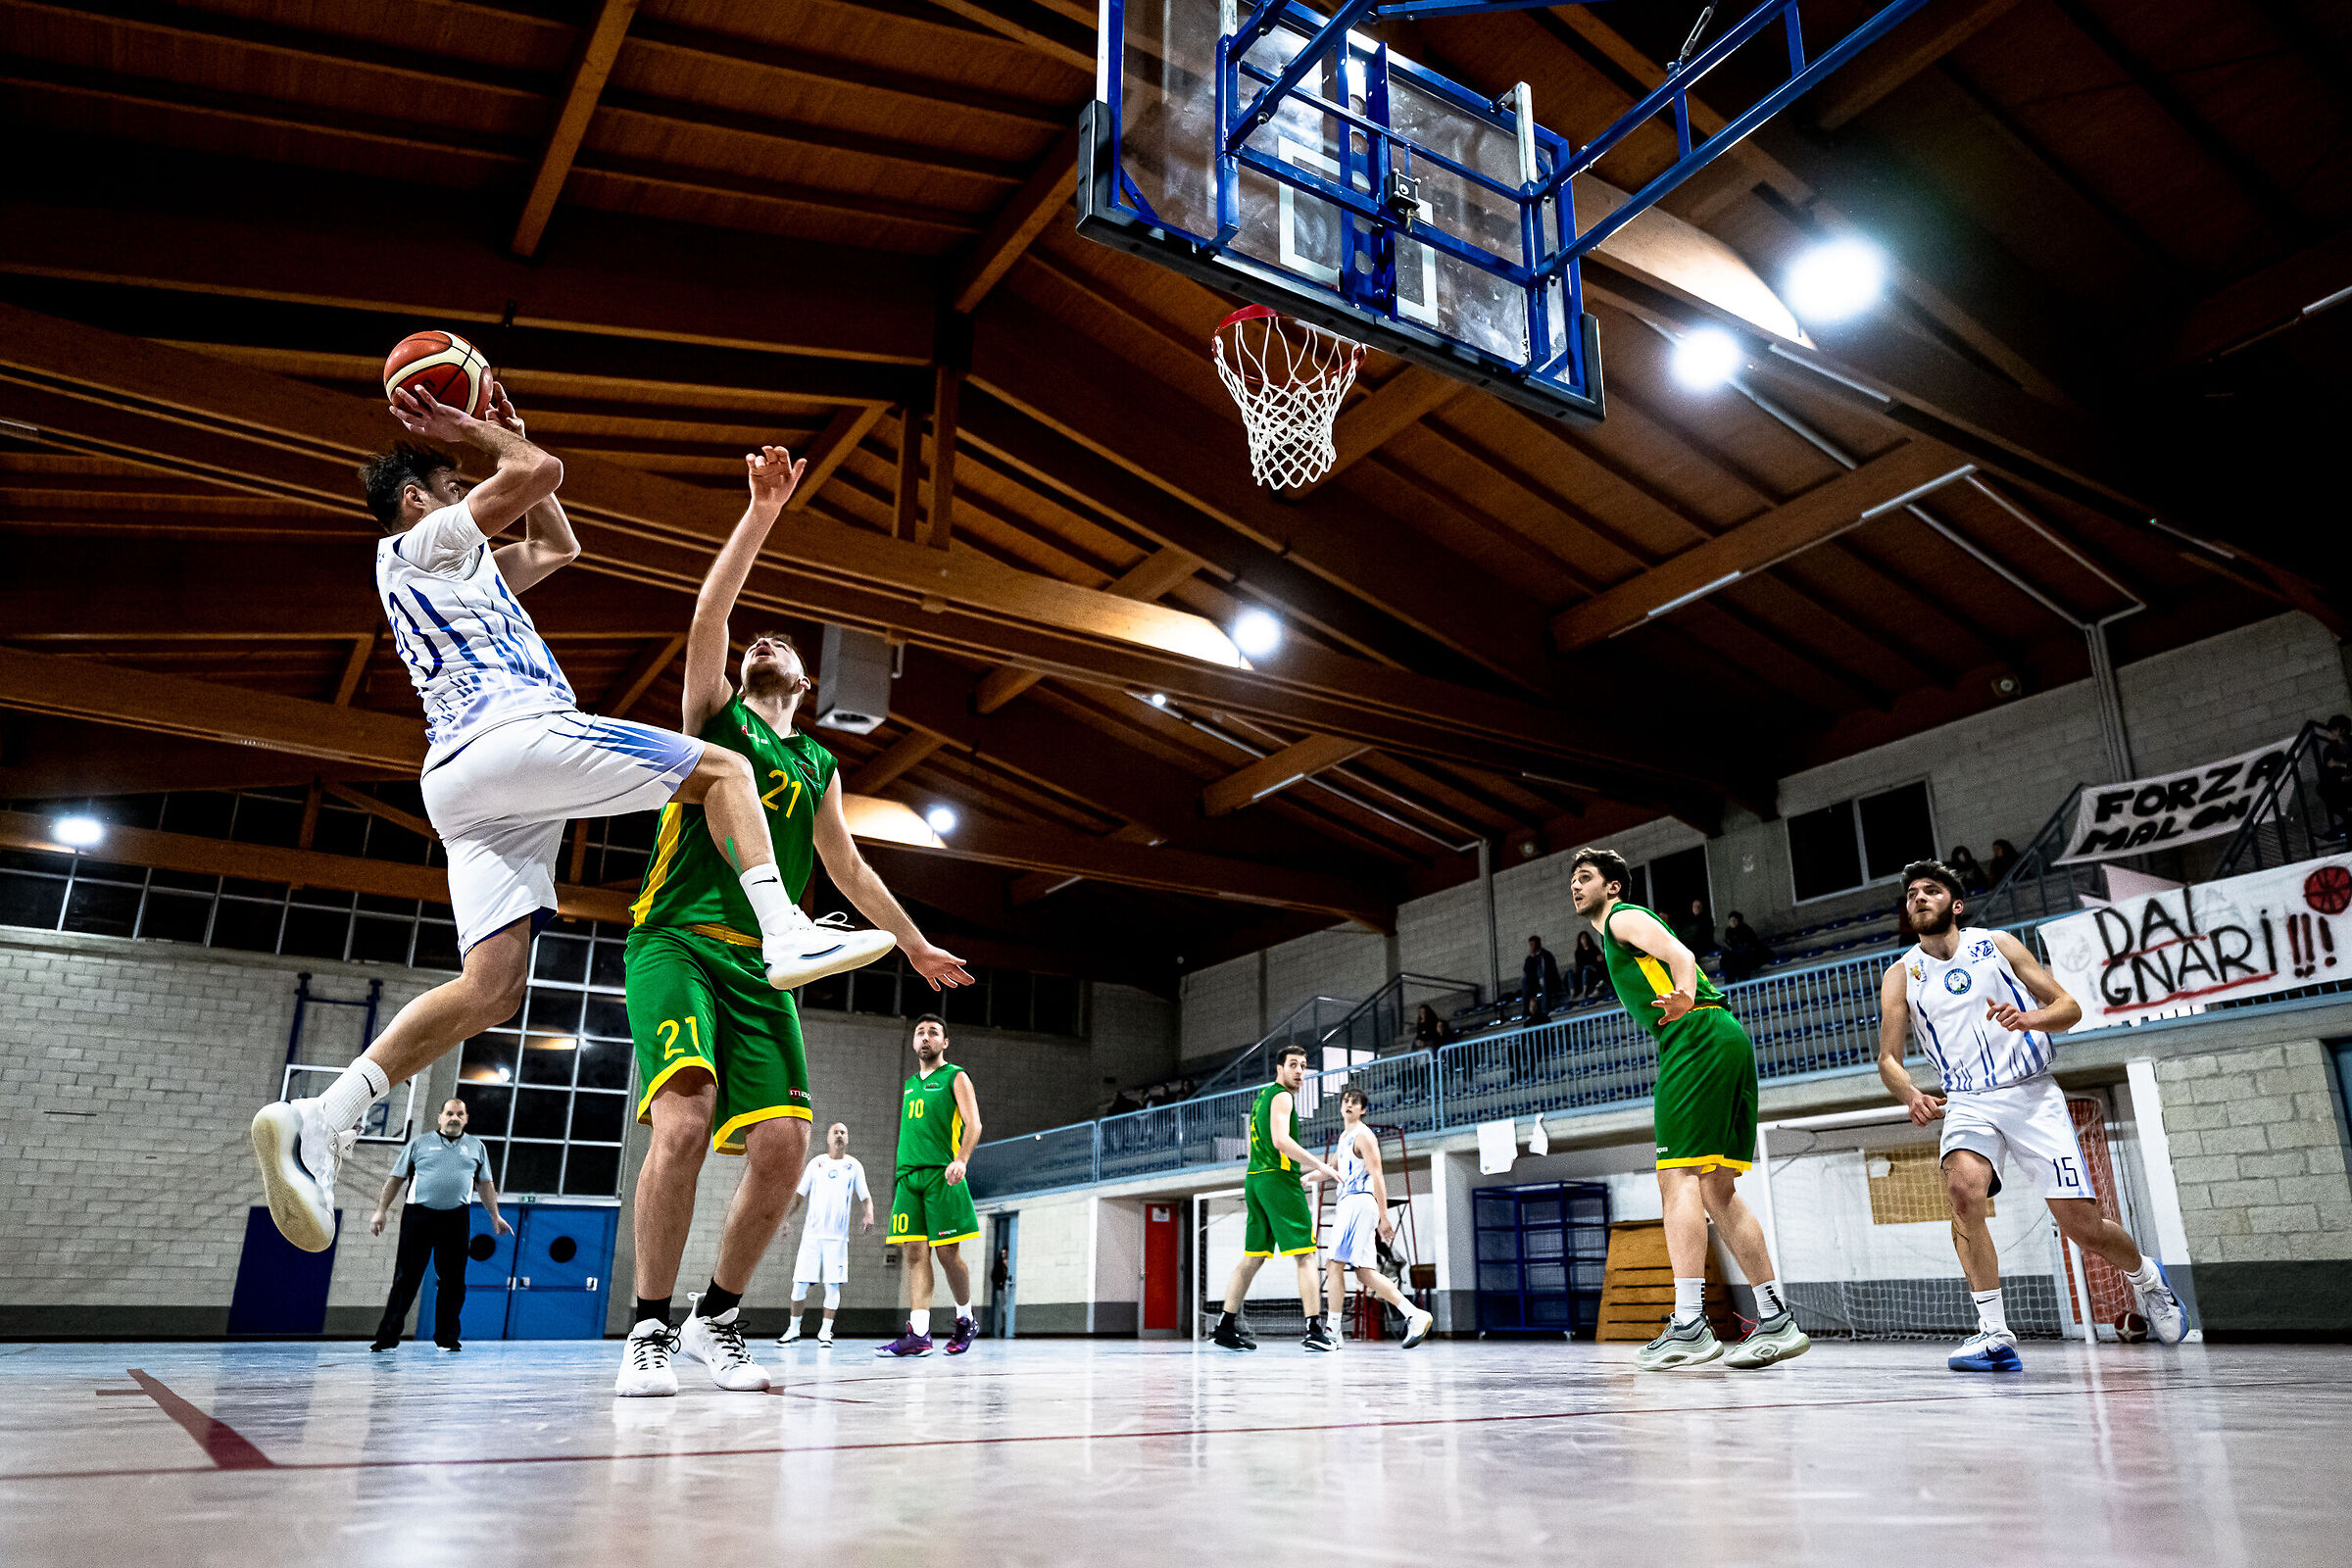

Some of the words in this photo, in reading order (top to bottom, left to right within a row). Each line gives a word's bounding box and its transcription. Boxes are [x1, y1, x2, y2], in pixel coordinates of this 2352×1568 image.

[760, 769, 802, 818] 21
[2094, 750, 2286, 823] FORZA
[2093, 884, 2202, 961] DAI
[657, 1016, 703, 1060] 21
[908, 1098, 924, 1119] 10
[2053, 1156, 2079, 1187] 15
[892, 1213, 908, 1233] 10
